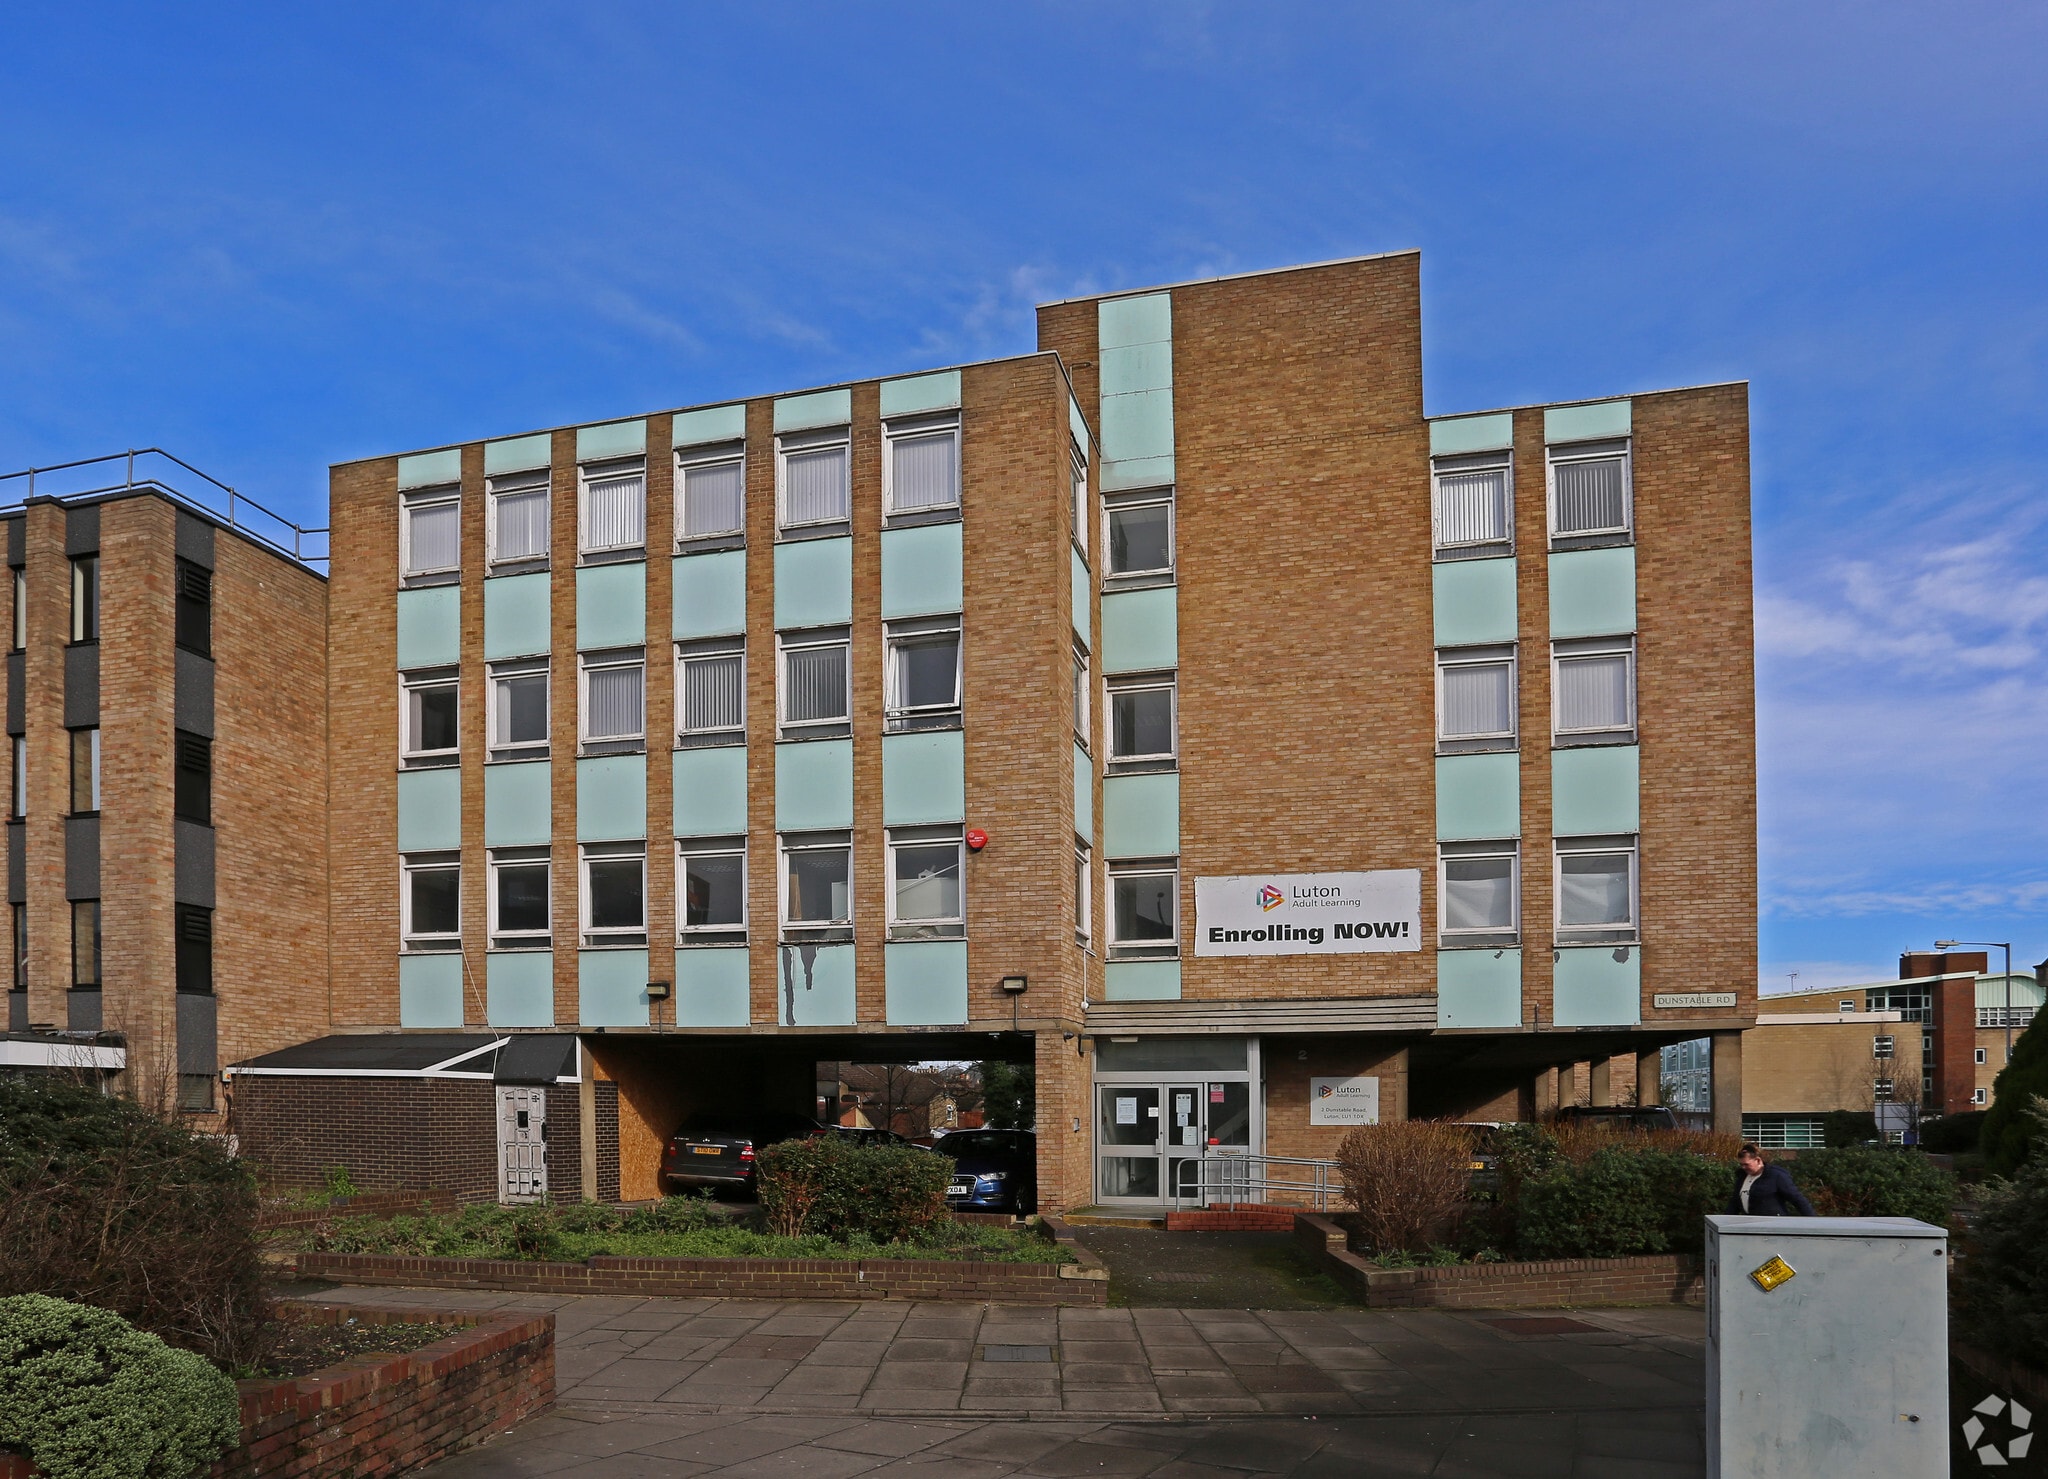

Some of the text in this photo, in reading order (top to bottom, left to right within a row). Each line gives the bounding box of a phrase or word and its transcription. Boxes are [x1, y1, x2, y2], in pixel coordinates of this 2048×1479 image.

[1292, 885, 1341, 899] Luton
[1292, 898, 1361, 908] Adult Learning
[1208, 922, 1410, 944] Enrolling NOW!
[1658, 996, 1731, 1005] DUNSTABLE RD
[1298, 1049, 1308, 1060] 2
